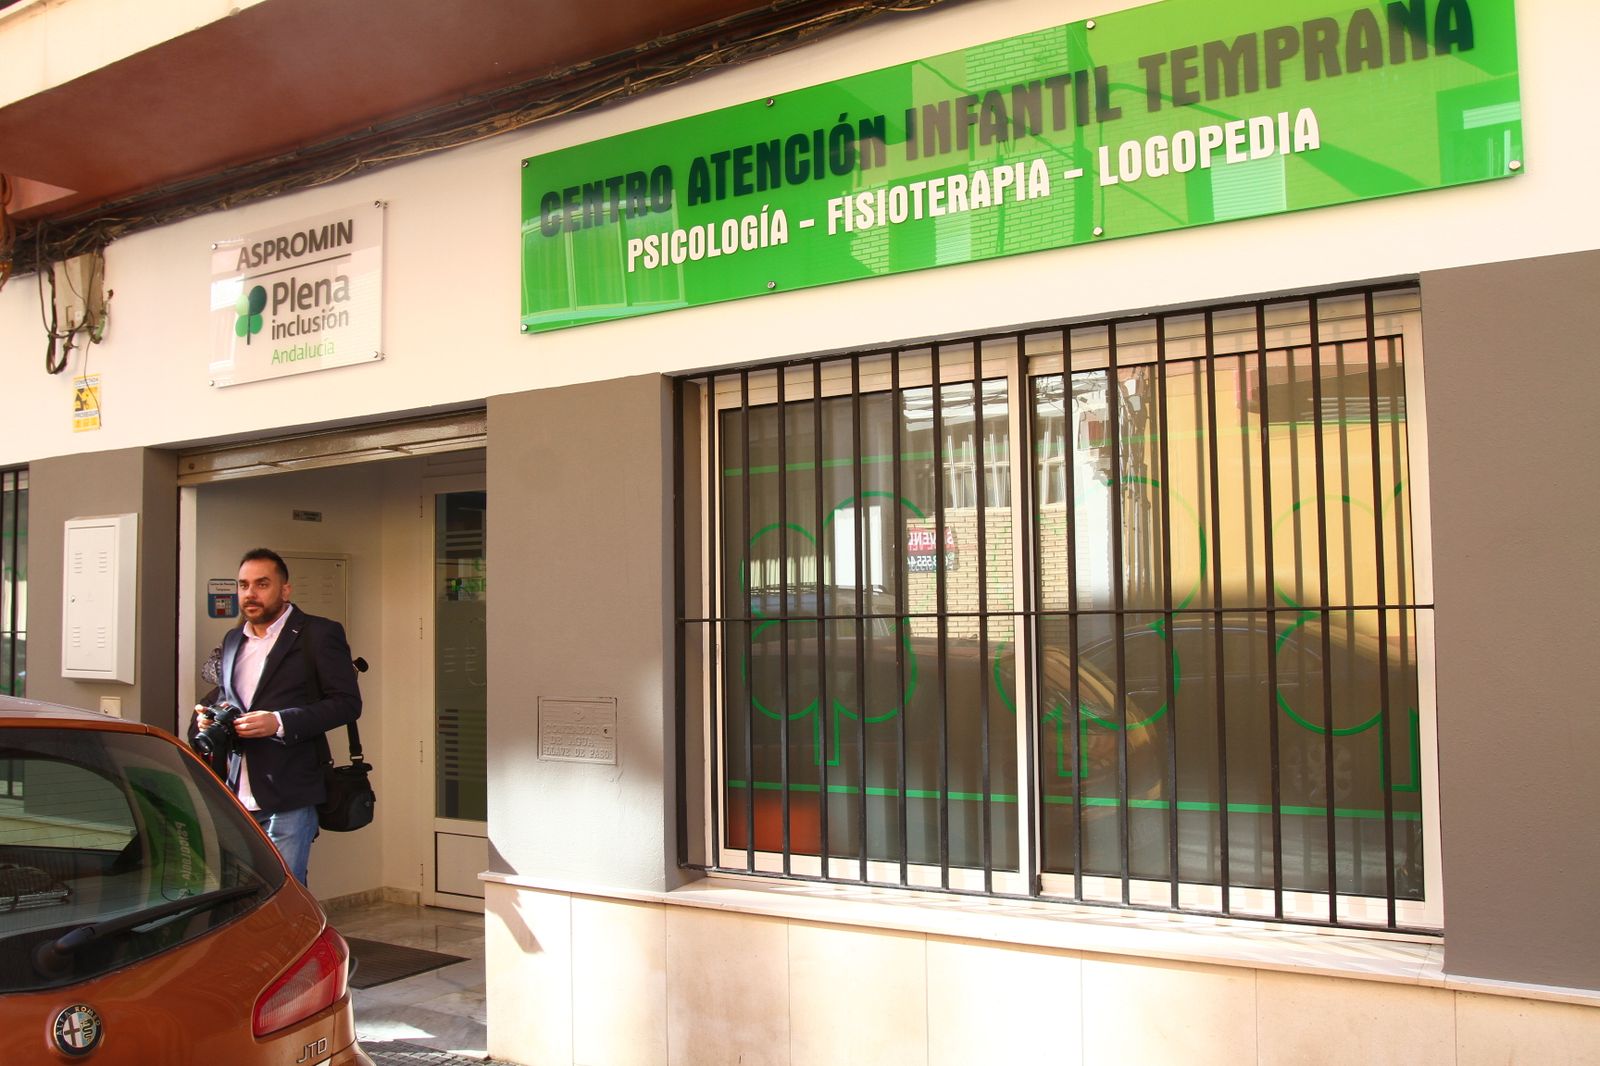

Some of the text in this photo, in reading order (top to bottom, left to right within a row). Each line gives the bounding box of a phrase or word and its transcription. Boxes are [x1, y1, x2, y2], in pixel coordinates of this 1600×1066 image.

[540, 0, 1475, 237] CENTRO ATENCIÓN INFANTIL TEMPRANA
[628, 205, 789, 272] PSICOLOGÍA
[827, 158, 1050, 235] FISIOTERAPIA
[1099, 107, 1320, 187] LOGOPEDIA
[236, 219, 353, 271] ASPROMIN
[272, 274, 350, 317] Plena
[271, 306, 349, 341] inclusión
[271, 337, 335, 365] Andalucía
[56, 1010, 71, 1036] ALFA
[297, 1038, 327, 1063] JTD
